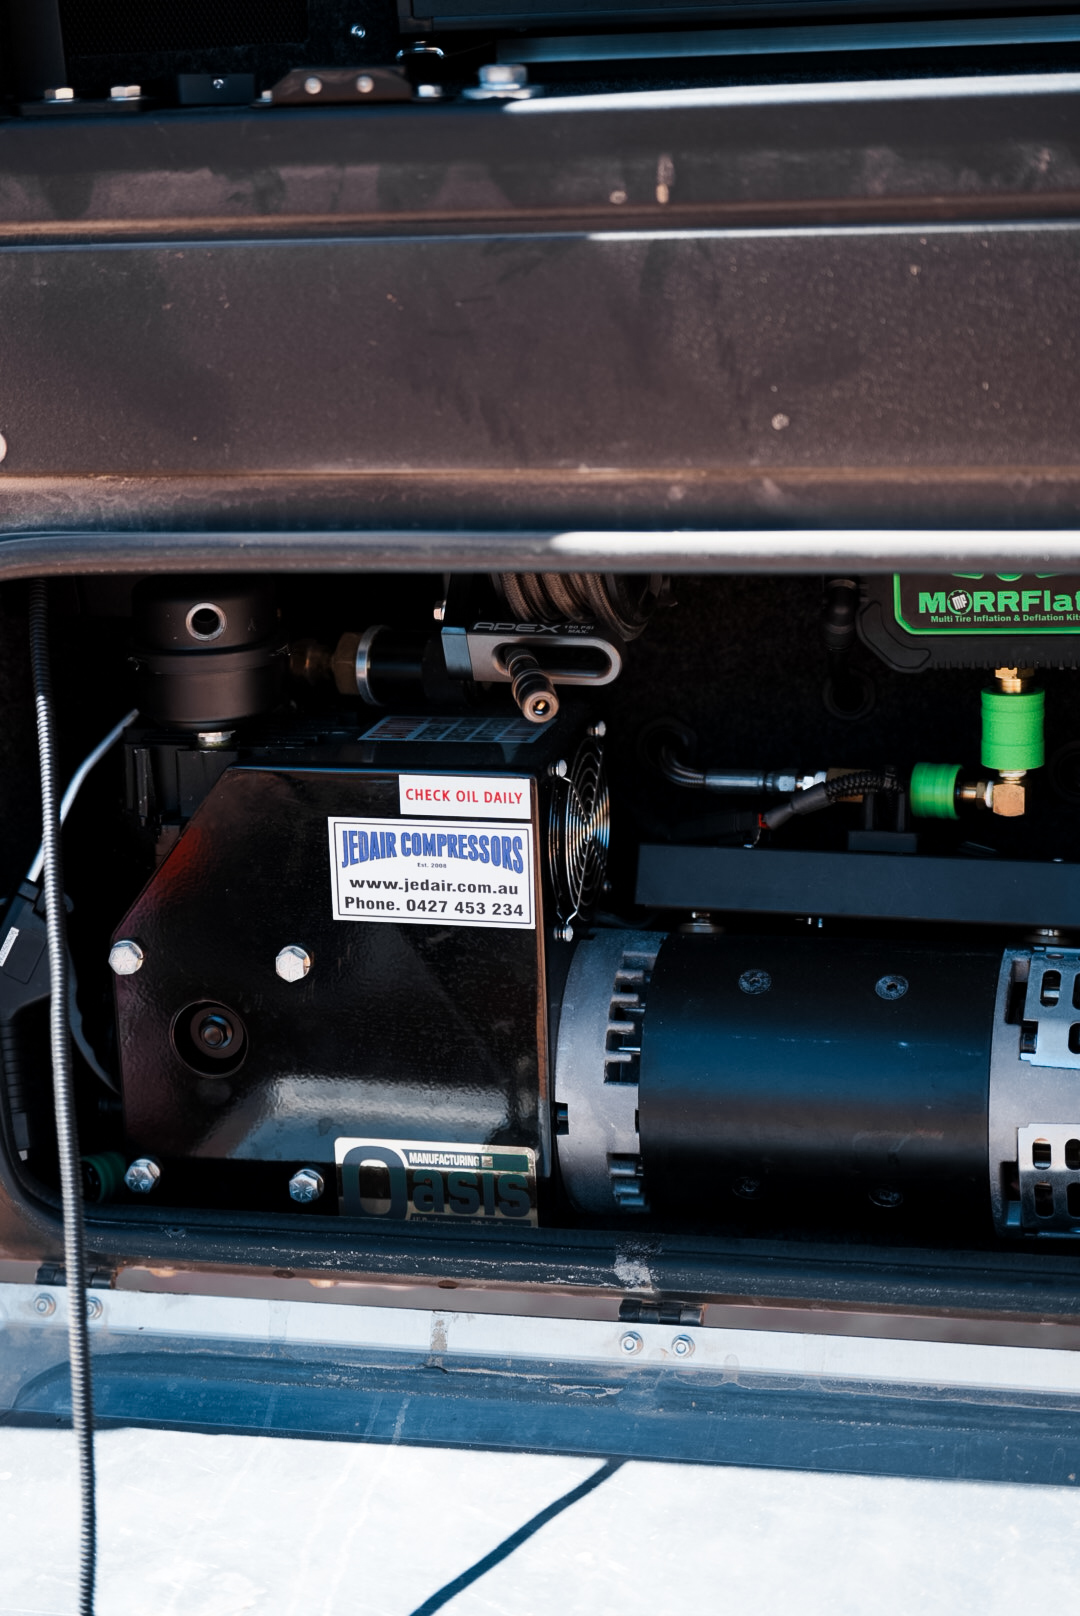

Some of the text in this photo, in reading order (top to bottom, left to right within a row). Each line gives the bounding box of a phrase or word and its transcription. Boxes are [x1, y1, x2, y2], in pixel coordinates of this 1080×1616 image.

[931, 615, 953, 623] Multi
[955, 615, 971, 623] Tire
[974, 614, 1011, 622] Inflation
[1013, 614, 1021, 622] &
[1023, 613, 1064, 622] Deflation
[473, 622, 561, 634] APEX
[405, 788, 523, 804] CHECK OIL DAILY
[342, 830, 524, 874] JEDAIR COMPRESSORS
[349, 878, 518, 895] www.jedair.com.au
[344, 896, 523, 917] Phone. 0427 453 234
[409, 1152, 480, 1167] MANUFACTURING
[342, 1146, 530, 1219] Oasis
